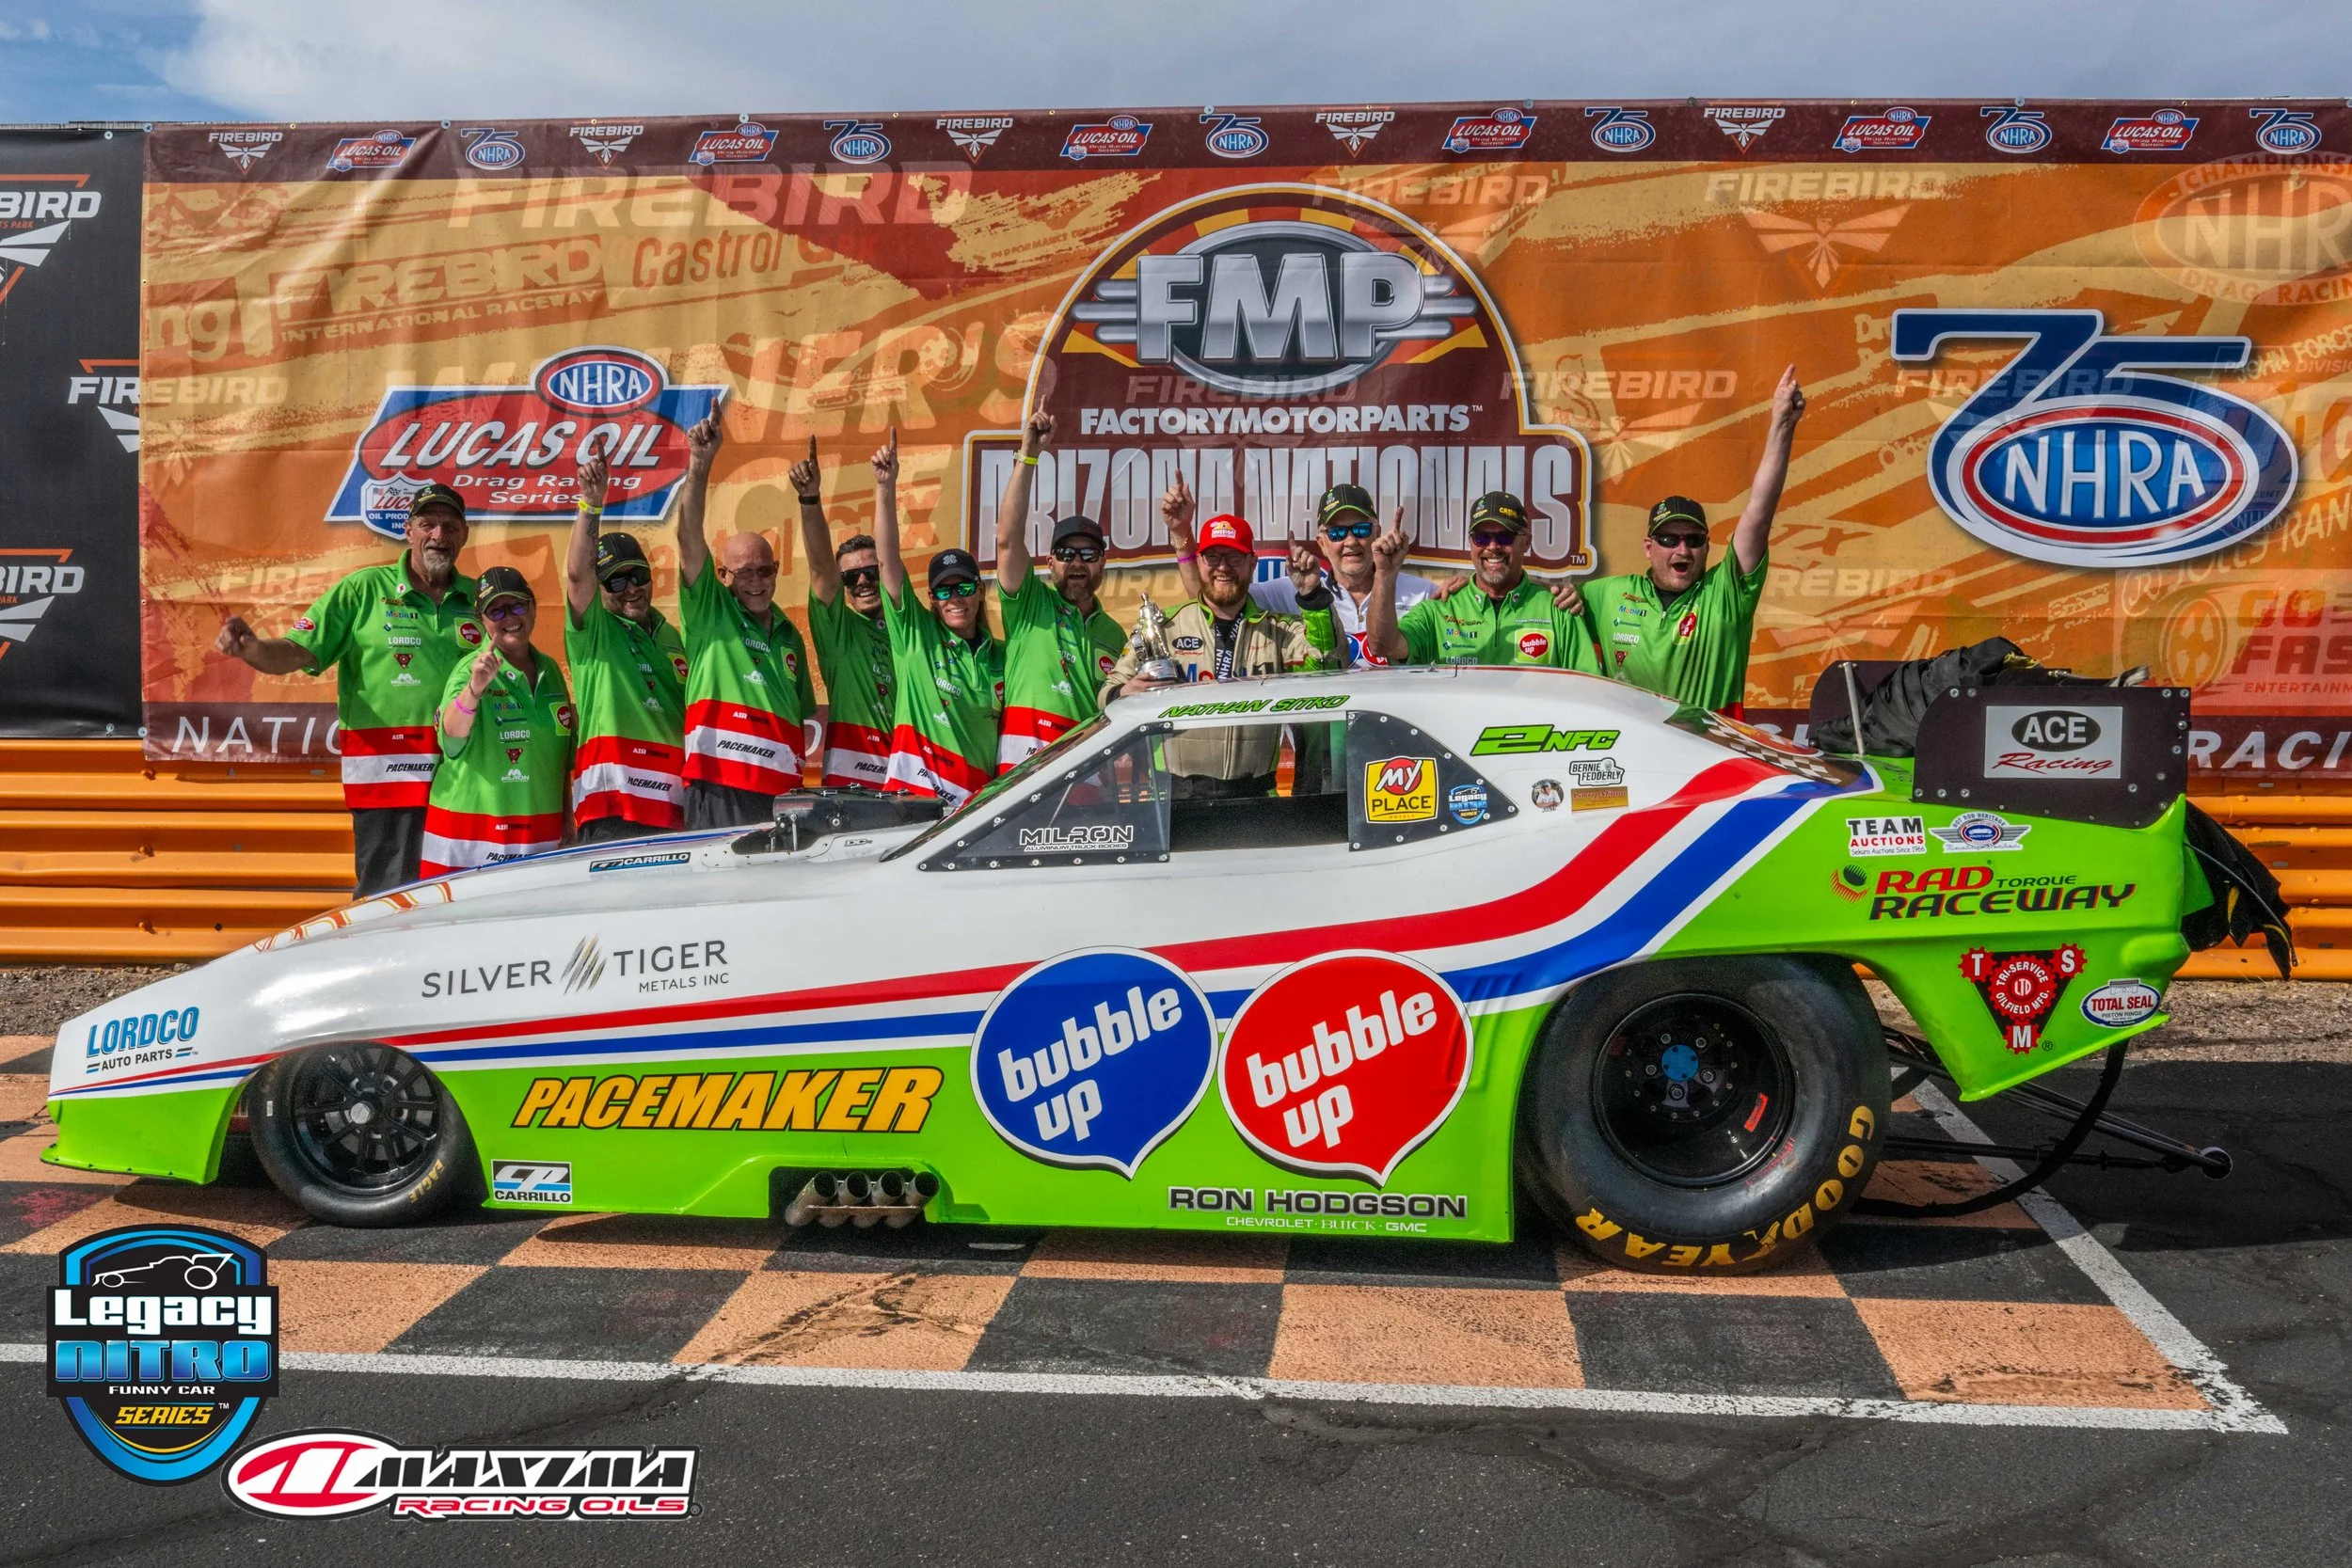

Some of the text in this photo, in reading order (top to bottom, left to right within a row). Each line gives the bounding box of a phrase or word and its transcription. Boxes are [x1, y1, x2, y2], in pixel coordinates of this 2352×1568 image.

[1315, 111, 1395, 123] FIREBIRD
[1496, 111, 1520, 121] NHRA
[1704, 107, 1786, 119] FIREBIRD
[1890, 111, 1912, 121] NHRA
[2156, 113, 2180, 123] NHRA
[569, 125, 644, 137] FIREBIRD
[739, 126, 761, 135] NHRA
[936, 118, 1013, 130] FIREBIRD
[1112, 119, 1136, 129] NHRA
[1455, 124, 1521, 137] LUCAS OIL
[1848, 124, 1915, 136] LUCAS OIL
[2116, 126, 2183, 139] LUCAS OIL
[209, 133, 282, 143] FIREBIRD
[377, 134, 399, 142] NHRA
[1073, 132, 1137, 144] LUCAS OIL
[1217, 134, 1254, 150] NHRA
[1604, 126, 1641, 143] NHRA
[2000, 129, 2037, 146] NHRA
[2269, 130, 2306, 146] NHRA
[340, 145, 402, 157] LUCAS OIL
[701, 137, 764, 150] LUCAS OIL
[841, 139, 876, 155] NHRA
[478, 150, 511, 162] NHRA
[1704, 171, 1946, 201] FIREBIRD
[448, 162, 973, 228] FIREBIRD
[632, 230, 783, 290] Castrol
[277, 238, 602, 321] FIREBIRD
[1136, 252, 1424, 365] FMP
[559, 364, 644, 404] NHRA
[379, 421, 663, 468] LUCAS OIL
[453, 474, 642, 491] Drag Rang
[2003, 429, 2207, 519] NHRA
[488, 491, 583, 505] Series
[978, 448, 1235, 562] ARIZONA
[2236, 590, 2326, 627] GO
[388, 637, 421, 645] LORDCO
[1176, 639, 1200, 648] ACE
[1522, 639, 1547, 647] bubble
[1218, 650, 1232, 679] NHRA
[1158, 695, 1352, 719] NATHAN SITKO
[500, 730, 531, 740] LORDCO
[2022, 716, 2087, 743] ACE
[717, 739, 775, 759] PACEMAKER
[386, 763, 434, 772] PACEMAKER
[1572, 763, 1601, 773] BERNIE
[1992, 752, 2114, 775] Racing
[1581, 771, 1621, 782] FEDDERLY
[1372, 796, 1432, 812] PLACE
[1848, 817, 1923, 835] TEAM
[1977, 813, 2007, 826] HERITAGE
[1019, 825, 1134, 846] MILRON
[1851, 836, 1924, 847] AUCTIONS
[623, 852, 691, 865] CARRILLO
[1875, 865, 2077, 895] RAD TORQUE
[1869, 883, 2137, 921] RACEWAY
[421, 940, 728, 999] SILVER TIGER
[1971, 949, 2075, 976] T S
[1995, 961, 2048, 987] TRI-SERVICE
[638, 973, 730, 993] METALS INC
[2014, 978, 2032, 996] LTD
[1995, 991, 2030, 1015] OILFIELD
[2091, 995, 2153, 1011] TOTAL SEAL
[86, 1006, 199, 1058] LORDCO
[2012, 1025, 2032, 1048] M
[997, 986, 1183, 1102] bubble
[1246, 990, 1438, 1108] bubble
[101, 1049, 173, 1071] AUTO PARTS
[511, 1066, 944, 1133] PACEMAKER
[1034, 1079, 1103, 1142] up
[1282, 1085, 1354, 1148] up
[408, 1157, 444, 1204] EAGLE
[494, 1190, 571, 1202] CARRILLO
[1168, 1187, 1469, 1219] RON HODGSON
[1227, 1216, 1427, 1232] CHEVROLET BUICK GMC
